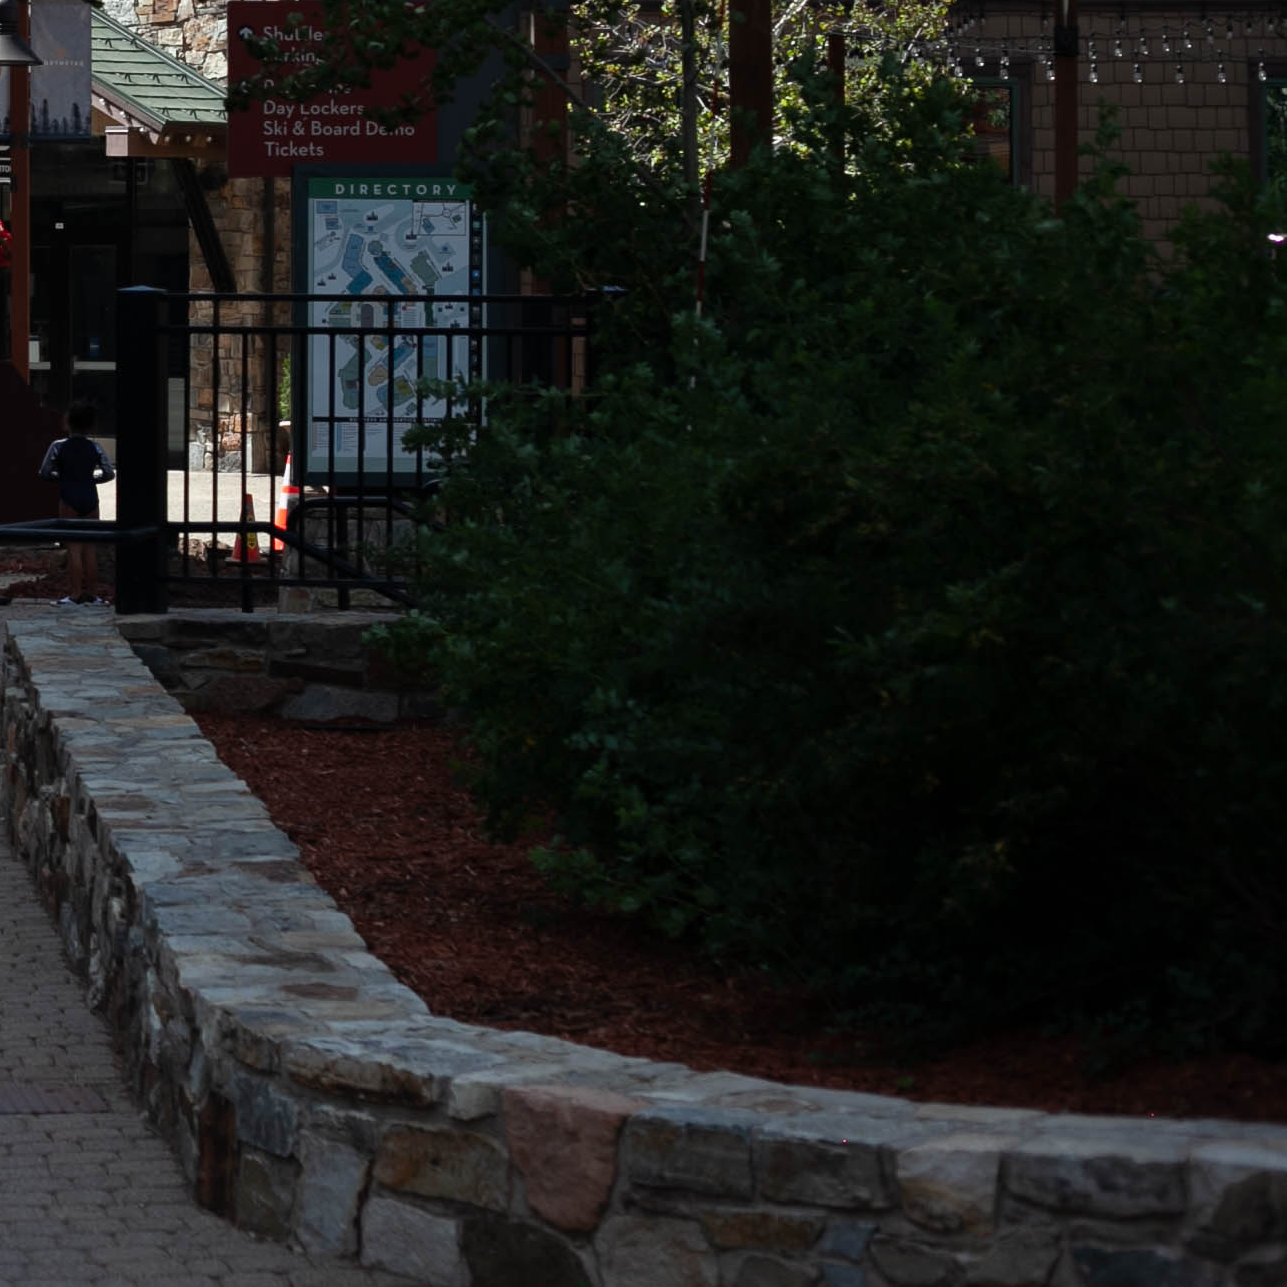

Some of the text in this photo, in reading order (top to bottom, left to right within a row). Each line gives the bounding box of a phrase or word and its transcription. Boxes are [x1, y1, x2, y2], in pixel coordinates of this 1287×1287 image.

[263, 26, 323, 42] Shutle
[263, 99, 364, 118] Day Lockers
[263, 120, 288, 136] Ski
[292, 120, 306, 136] &
[310, 120, 360, 136] Board
[263, 140, 324, 157] Tickets
[334, 183, 457, 196] DIRECTORY
